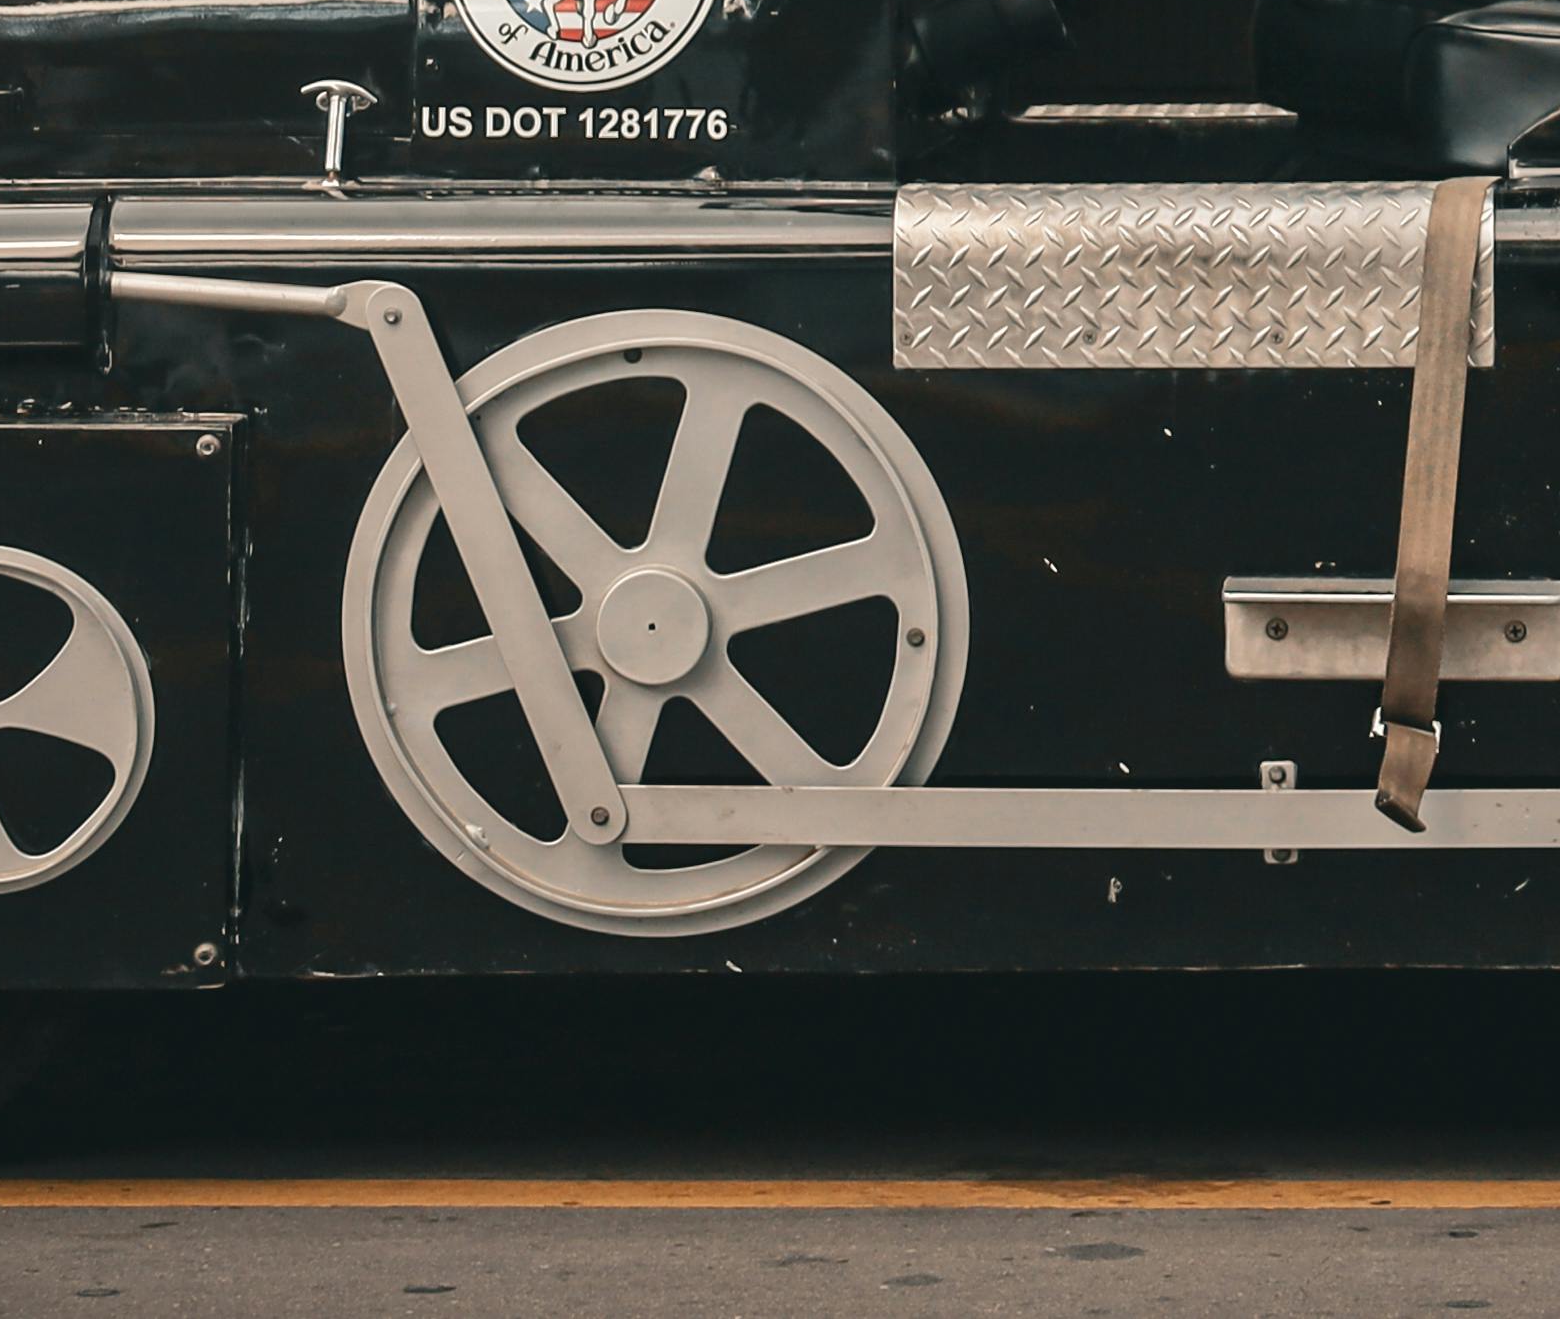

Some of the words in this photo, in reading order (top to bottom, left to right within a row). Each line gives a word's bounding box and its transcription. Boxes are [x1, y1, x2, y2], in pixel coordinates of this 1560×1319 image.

[498, 22, 528, 44] of
[529, 20, 670, 72] America
[422, 106, 473, 138] US
[486, 107, 566, 139] DOT
[578, 107, 728, 139] 1281776
